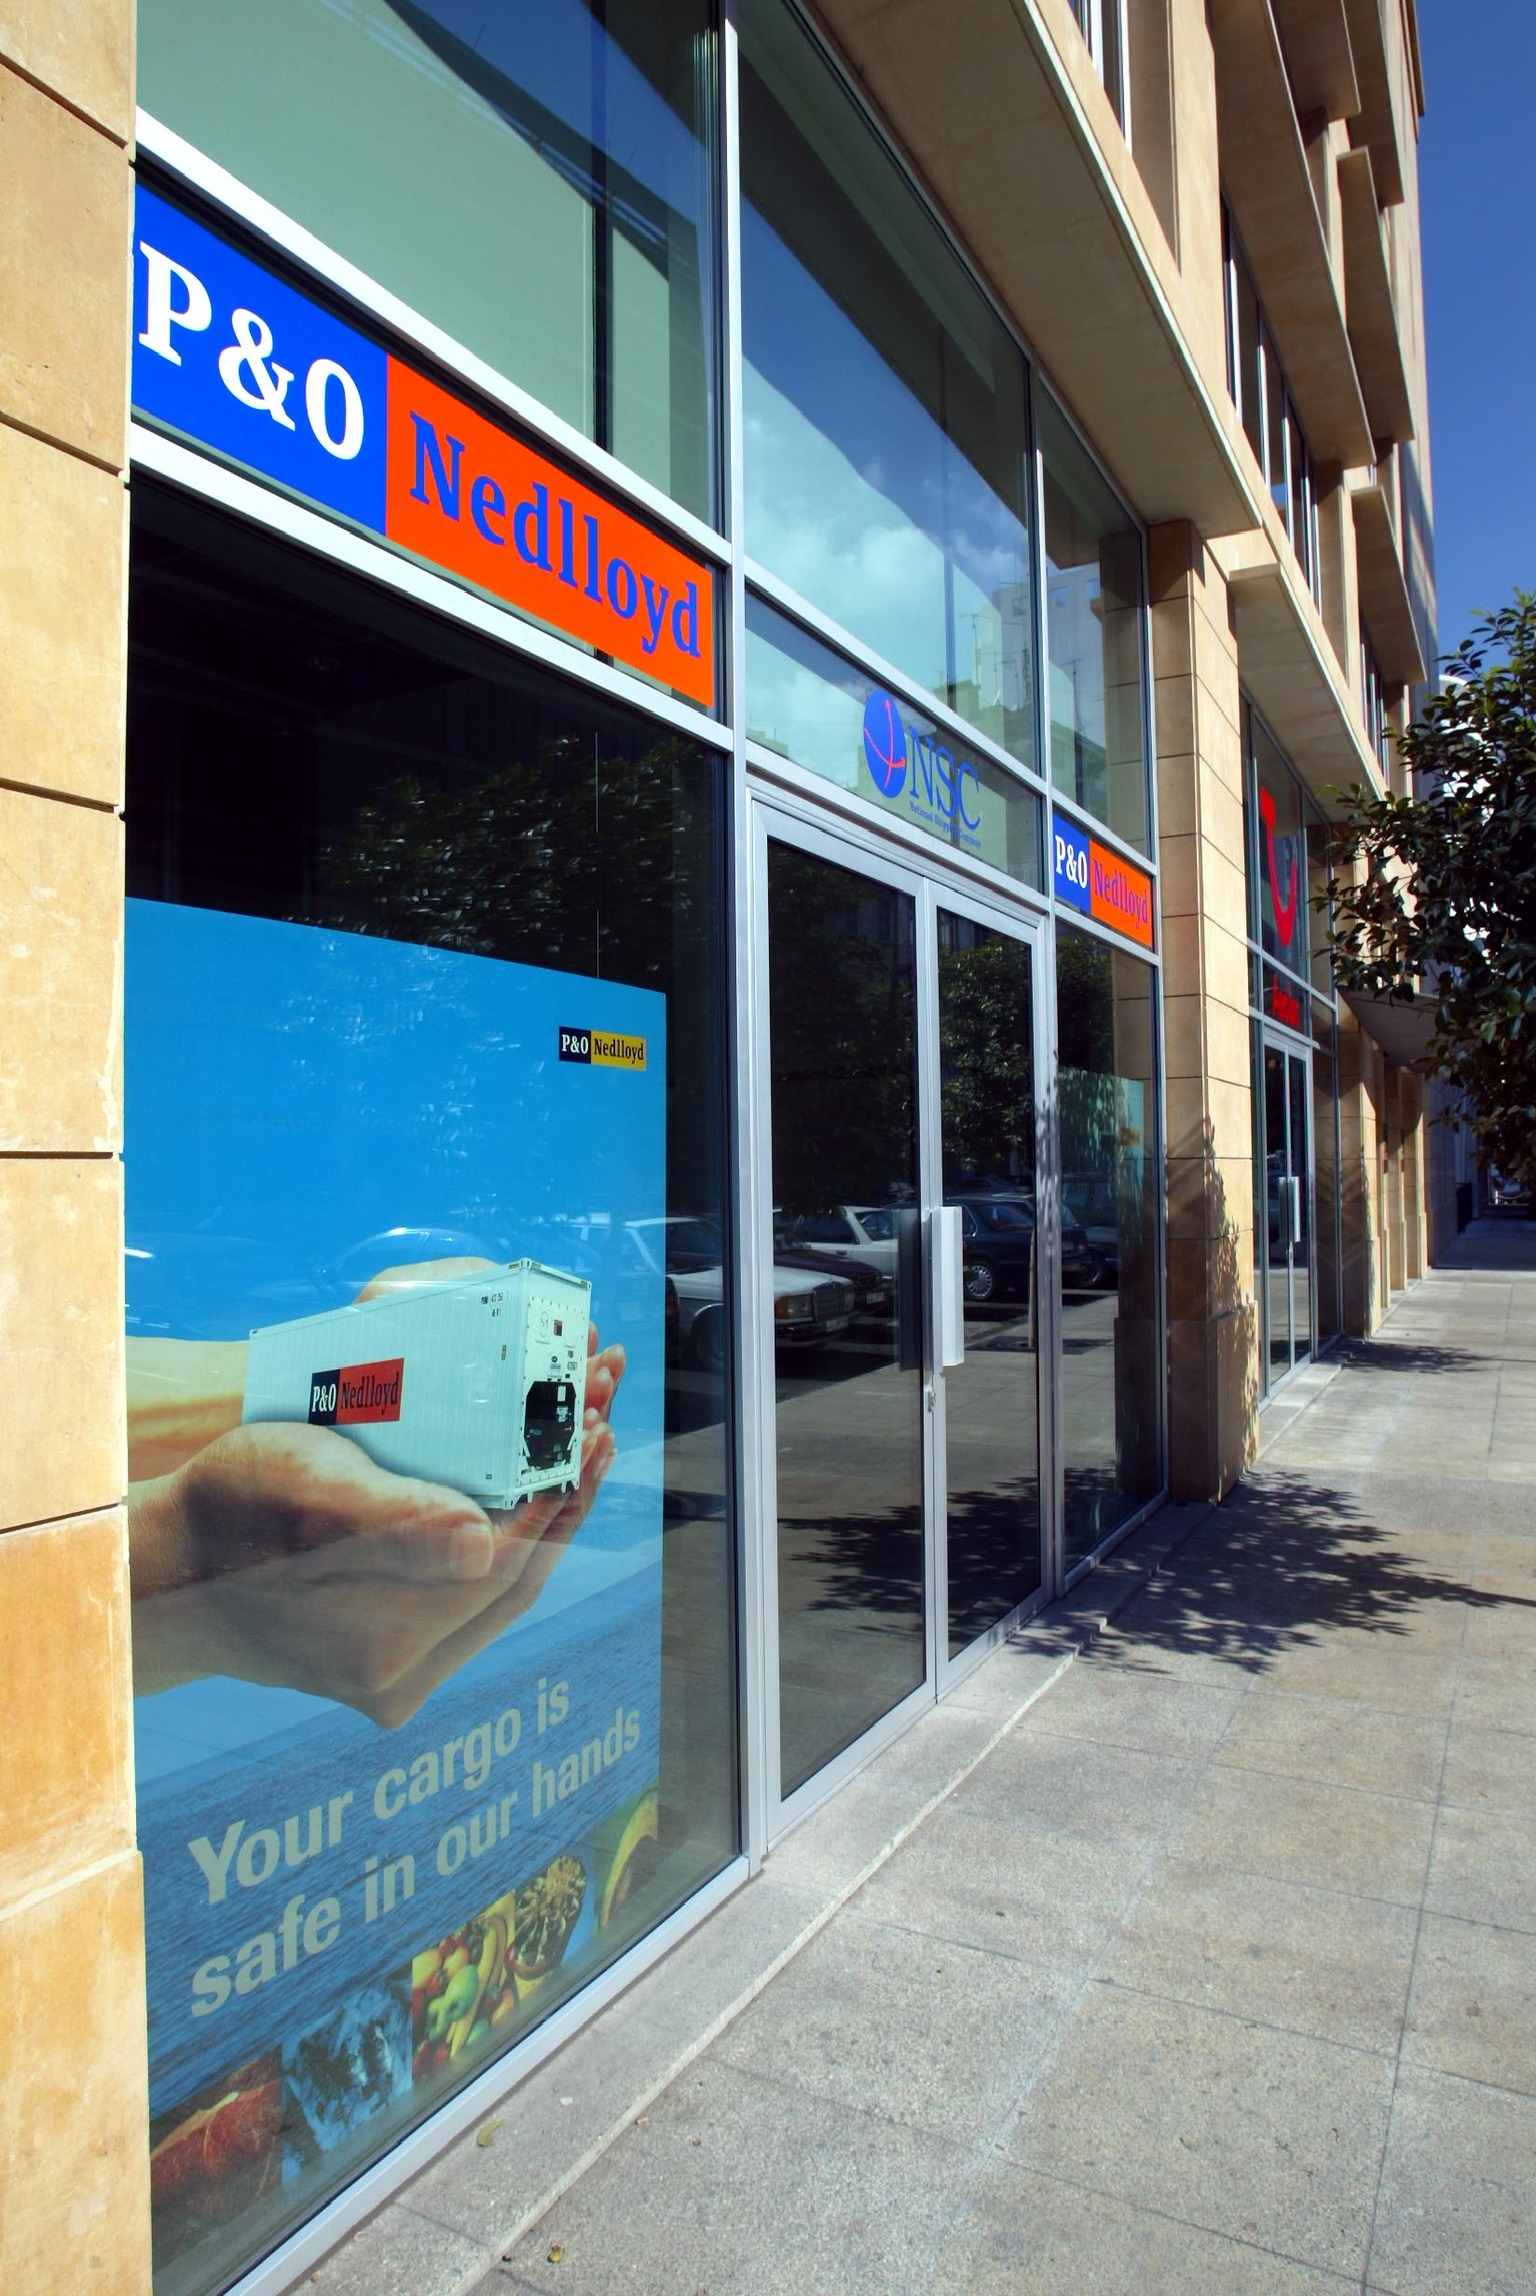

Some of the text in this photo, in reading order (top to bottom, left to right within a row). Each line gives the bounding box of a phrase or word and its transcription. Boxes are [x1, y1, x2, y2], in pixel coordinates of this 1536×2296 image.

[138, 240, 702, 659] P&O Nedlloyd
[908, 723, 981, 831] NSC
[1055, 834, 1150, 930] P&O Nedlloyd
[561, 1033, 645, 1065] P&O Nedlloyd
[311, 1370, 400, 1416] P&O Nedlloyd
[187, 1676, 570, 1906] Your cargo is
[190, 1706, 641, 2018] safe in our hands
